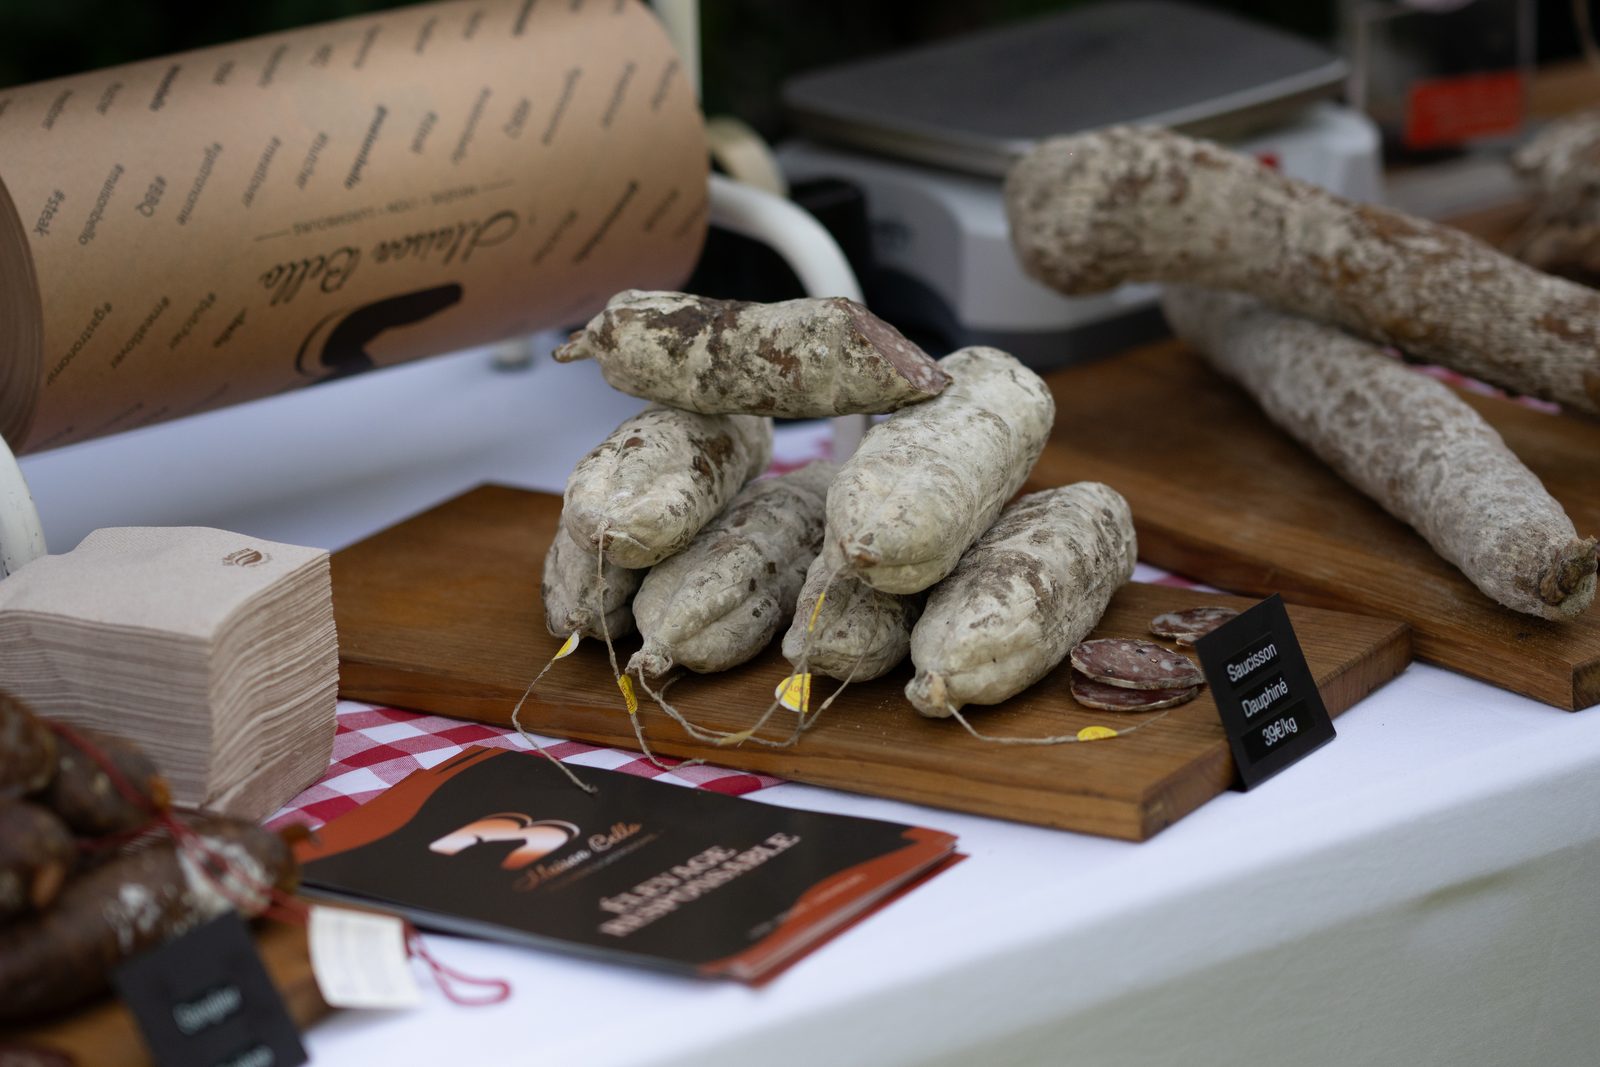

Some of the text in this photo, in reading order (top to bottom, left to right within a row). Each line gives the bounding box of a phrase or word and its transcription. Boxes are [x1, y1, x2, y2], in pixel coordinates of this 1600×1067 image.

[34, 188, 65, 237] #steak
[78, 163, 125, 245] #maisonbello
[135, 175, 167, 218] #BBQ
[374, 209, 520, 265] Maison
[259, 246, 361, 306] Bello
[111, 296, 170, 369] #meatlover
[168, 292, 216, 350] #butcher
[1226, 642, 1278, 682] Saucisson
[1241, 677, 1289, 718] Dauphiné
[1262, 716, 1298, 747] 39€/kg
